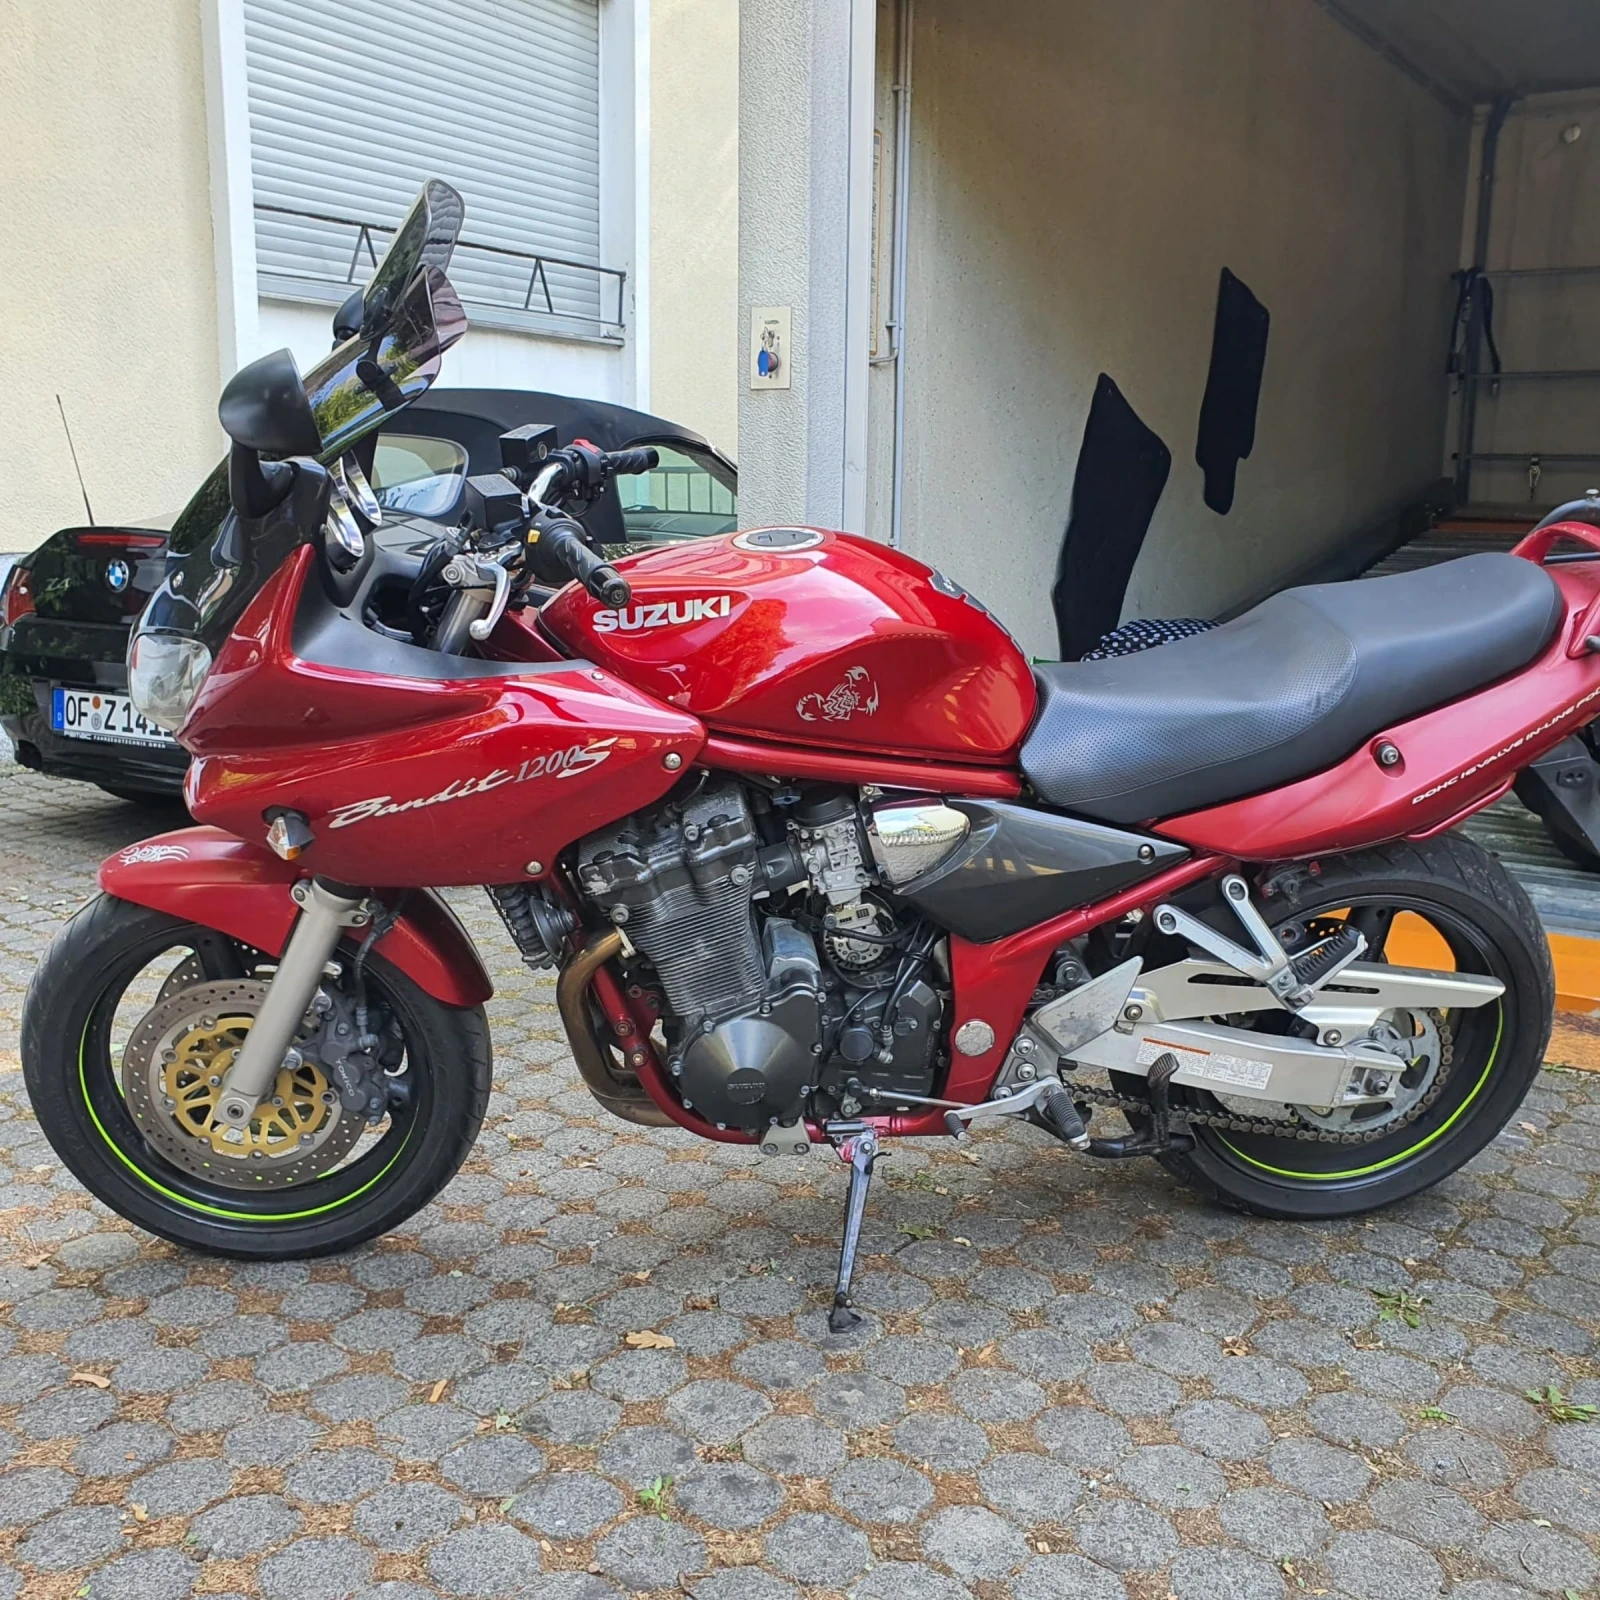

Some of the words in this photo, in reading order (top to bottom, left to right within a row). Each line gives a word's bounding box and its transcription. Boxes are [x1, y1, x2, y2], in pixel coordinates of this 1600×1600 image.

[592, 595, 731, 632] SUZUKI
[66, 695, 90, 726] OF
[104, 699, 117, 730] Z
[122, 702, 173, 737] 14
[1412, 776, 1458, 805] DOHC
[1525, 705, 1574, 741] IN-LINE
[328, 768, 514, 829] Bandit
[335, 1057, 355, 1097] TOKICO
